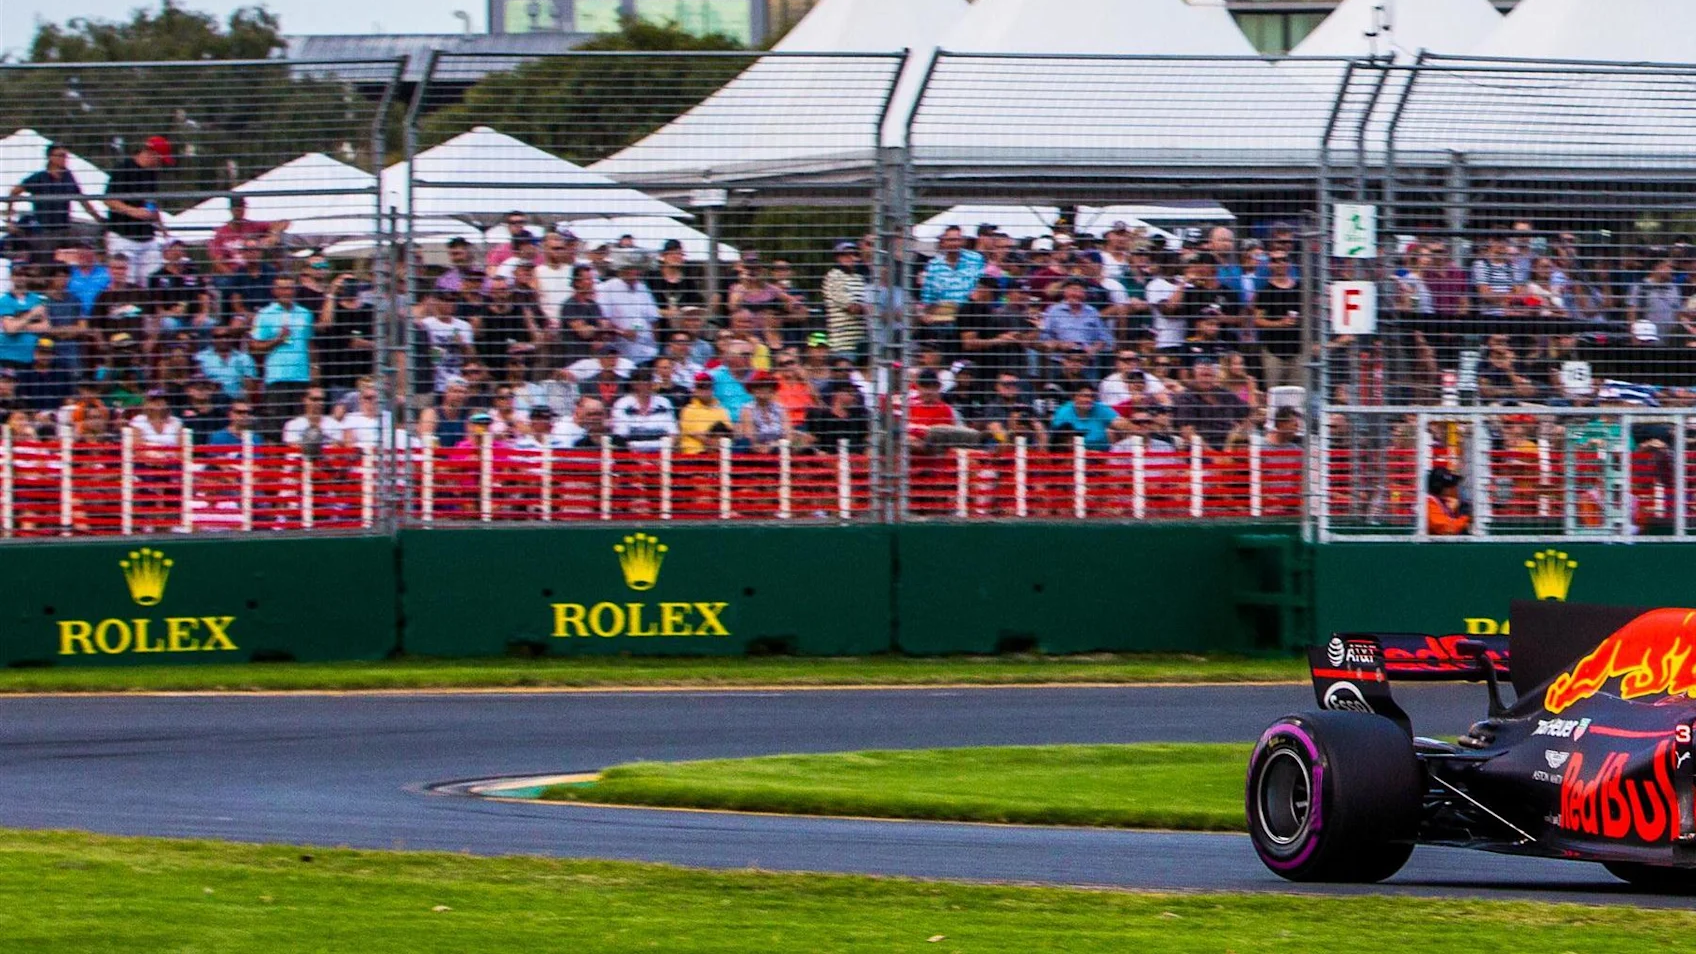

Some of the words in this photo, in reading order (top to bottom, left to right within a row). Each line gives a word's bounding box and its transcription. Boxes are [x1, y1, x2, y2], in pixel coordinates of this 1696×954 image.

[1343, 289, 1363, 326] F
[57, 617, 239, 655] ROLEX
[551, 602, 730, 638] ROLEX
[1675, 725, 1691, 743] 3
